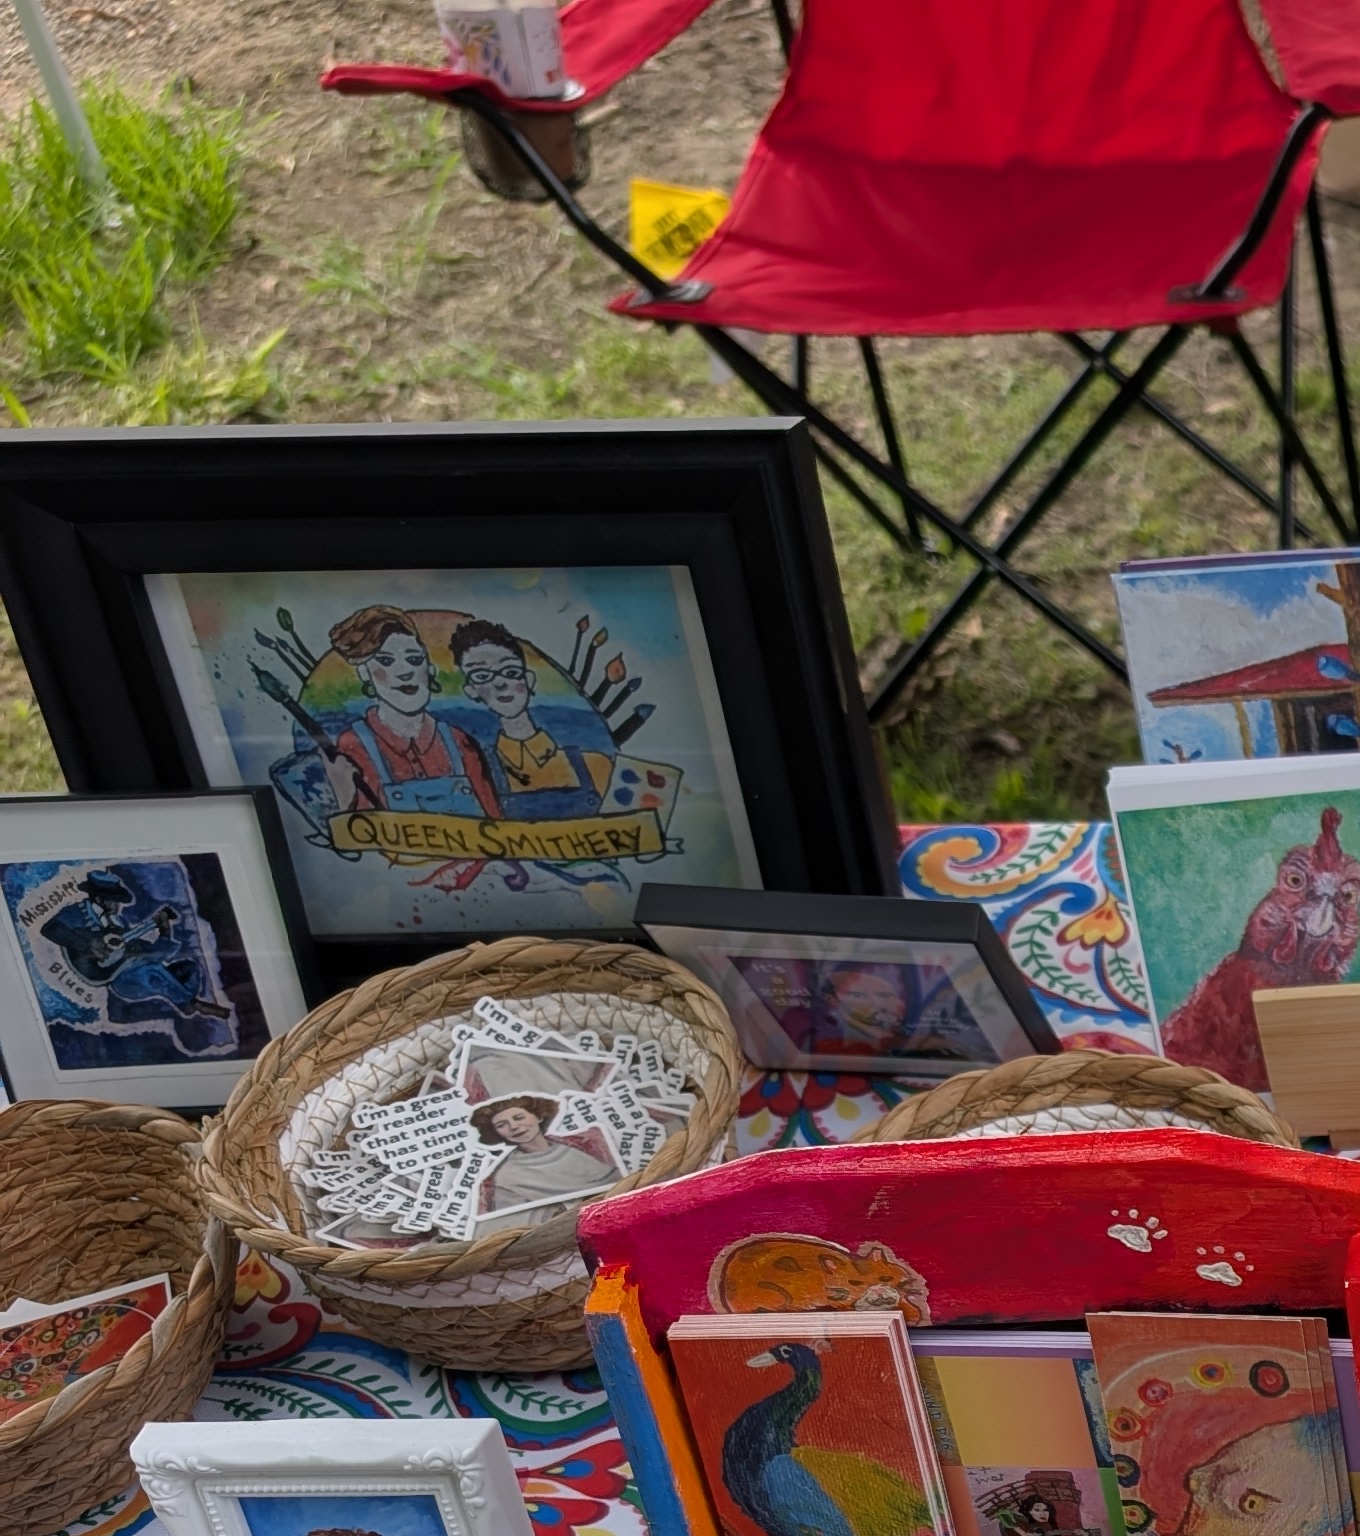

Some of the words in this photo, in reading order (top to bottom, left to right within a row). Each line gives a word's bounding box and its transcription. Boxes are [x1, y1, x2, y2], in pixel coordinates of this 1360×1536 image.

[348, 813, 469, 852] QUEEN
[471, 820, 643, 860] SMITHERY
[48, 961, 94, 1004] Blues
[480, 1001, 509, 1025] I'm
[511, 1022, 524, 1033] a
[357, 1109, 389, 1125] I'm
[394, 1103, 406, 1114] a
[409, 1089, 463, 1112] great
[574, 1098, 598, 1124] tha
[613, 1083, 636, 1109] I'm
[630, 1109, 644, 1120] a
[366, 1131, 411, 1150] that
[414, 1114, 469, 1137] never
[382, 1107, 448, 1131] reader
[383, 1142, 419, 1160] has
[422, 1129, 469, 1148] time
[396, 1158, 418, 1170] to
[422, 1142, 467, 1163] read
[619, 1131, 639, 1157] has
[322, 1173, 355, 1188] I'm
[354, 1165, 368, 1174] a
[423, 1164, 446, 1201] great
[460, 1152, 487, 1190] great
[420, 1201, 434, 1209] a
[454, 1190, 468, 1200] a
[438, 1201, 463, 1223] I'm
